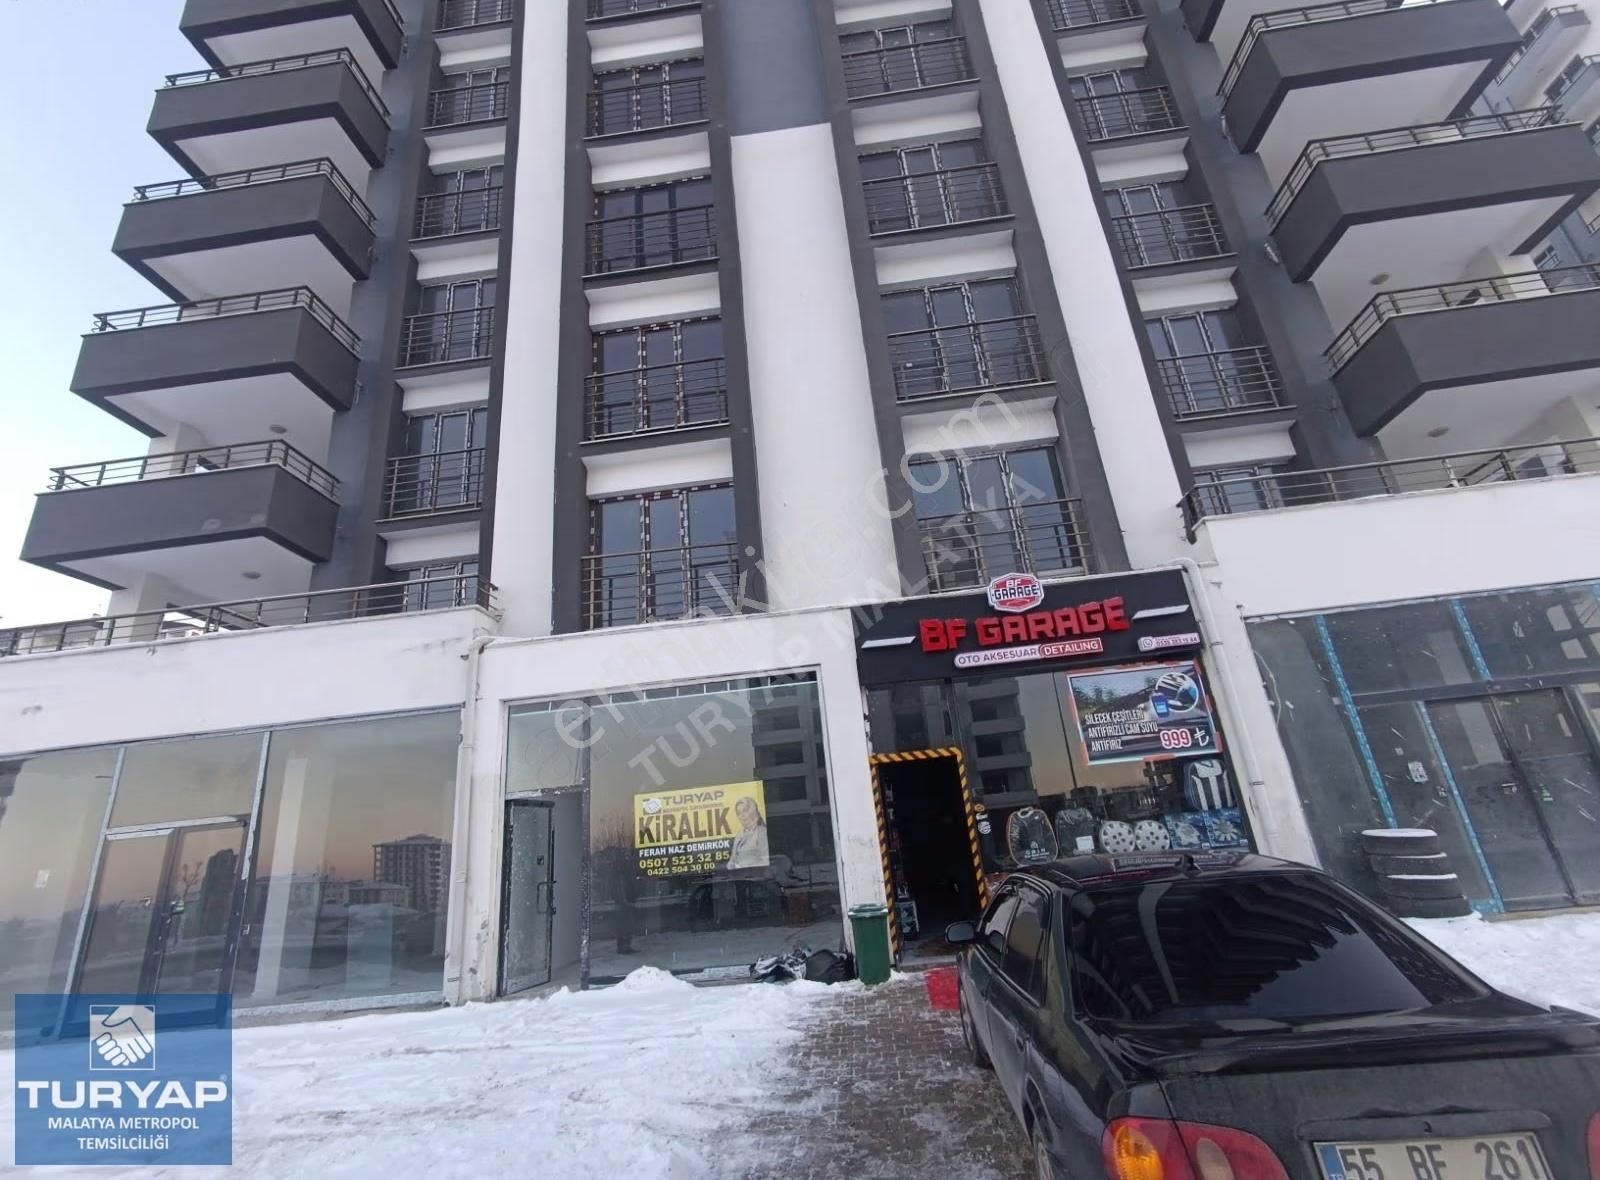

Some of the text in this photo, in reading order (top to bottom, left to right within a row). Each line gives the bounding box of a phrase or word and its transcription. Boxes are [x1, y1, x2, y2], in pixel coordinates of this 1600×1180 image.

[1006, 579, 1021, 587] BF
[994, 584, 1038, 600] GARAGE
[919, 597, 1130, 652] BF GARAGE
[959, 640, 1099, 665] OTO AKSESUAR DETAILING
[1161, 729, 1192, 749] 999
[662, 791, 724, 806] TURYAP
[639, 847, 666, 858] FERAH
[668, 845, 685, 854] NAZ
[639, 857, 669, 869] 0507
[672, 855, 694, 865] 523
[697, 853, 712, 863] 32
[647, 867, 670, 876] 0422
[1339, 1139, 1540, 1180] 55 BF 261
